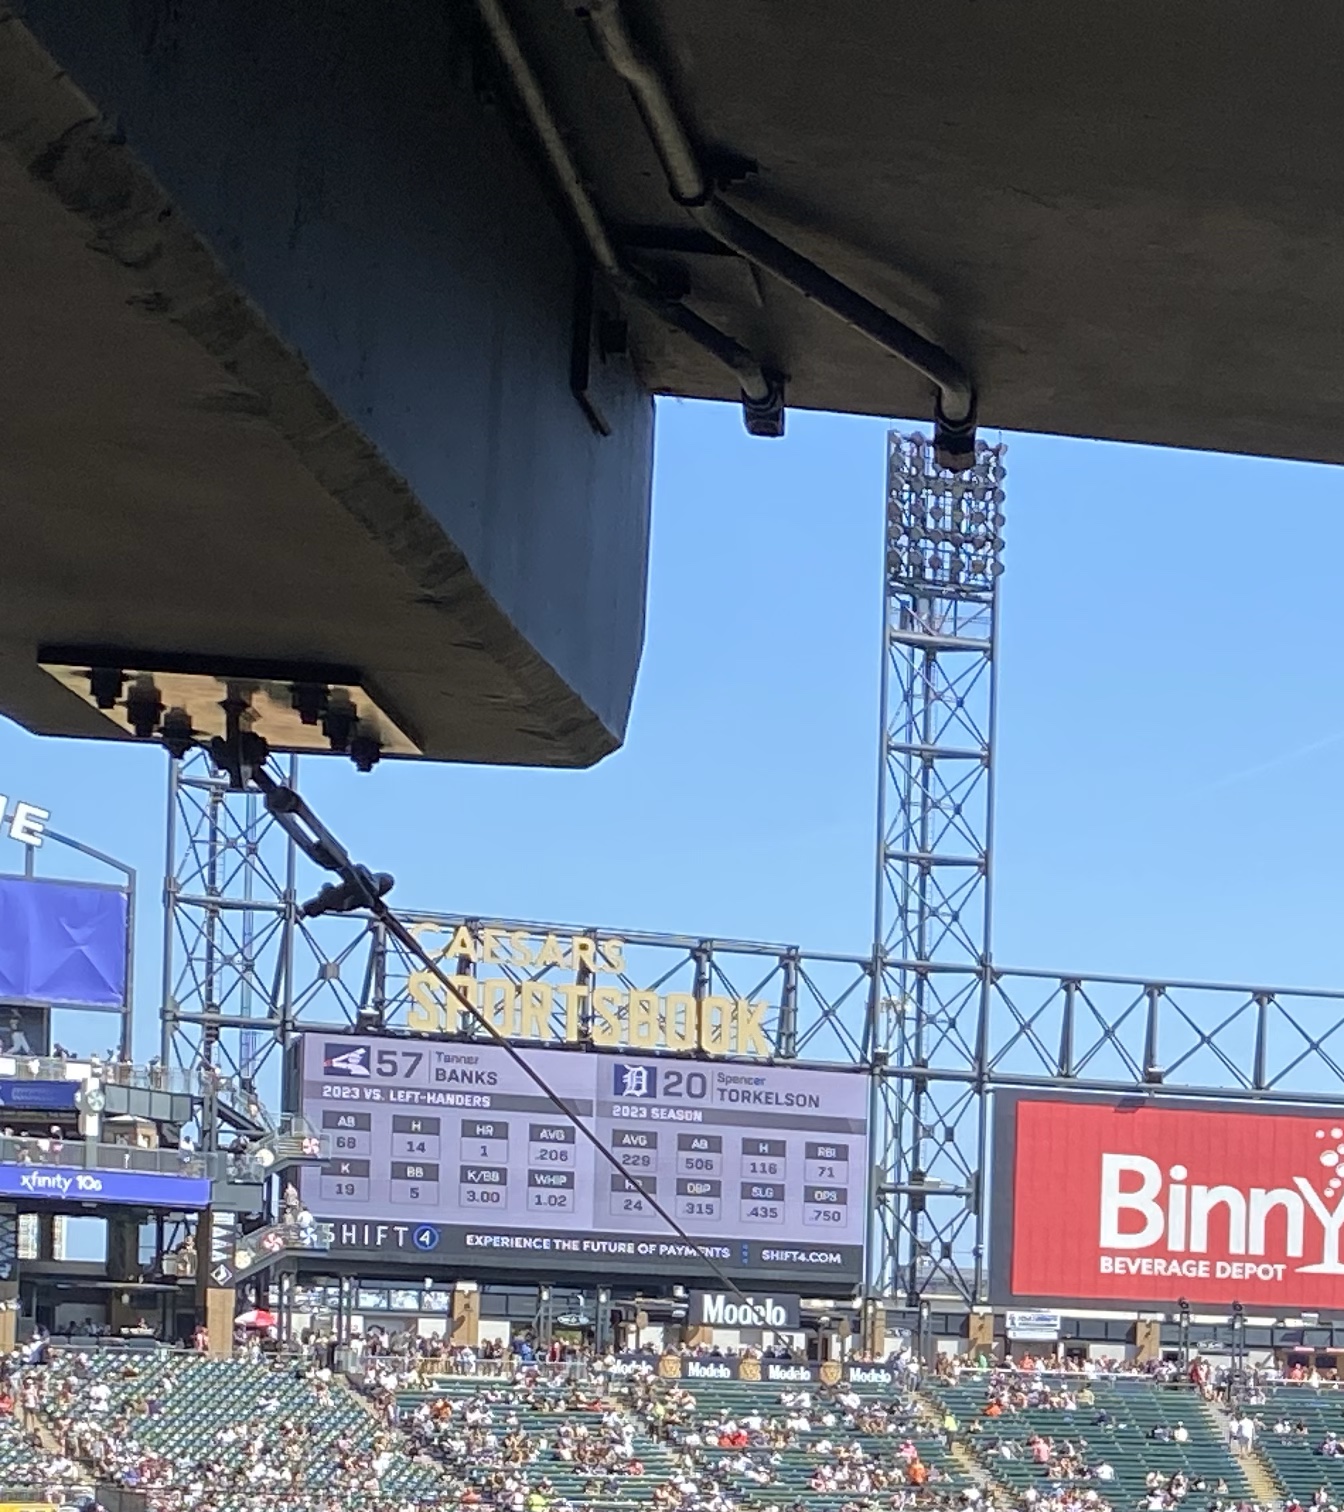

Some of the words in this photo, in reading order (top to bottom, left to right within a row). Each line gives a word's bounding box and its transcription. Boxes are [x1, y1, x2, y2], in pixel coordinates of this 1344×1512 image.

[409, 923, 625, 974] CAESARS
[408, 972, 771, 1057] SPORTSBOOK
[376, 1051, 423, 1078] 57
[436, 1051, 478, 1065] Tanner
[435, 1068, 498, 1085] BANKS
[663, 1071, 707, 1098] 20
[717, 1073, 766, 1086] Spencer
[323, 1085, 360, 1099] 2023
[364, 1088, 384, 1101] VS.
[390, 1090, 491, 1108] LEFT-HANDERS
[718, 1088, 820, 1108] TORKELSON
[613, 1106, 647, 1118] 2023
[651, 1108, 702, 1122] SEASON
[338, 1116, 355, 1127] AB
[476, 1125, 493, 1136] HR
[540, 1130, 564, 1140] AVG
[337, 1136, 356, 1148] 68
[407, 1141, 425, 1152] 14
[535, 1149, 568, 1162] .206
[622, 1135, 647, 1146] AVG
[692, 1139, 708, 1149] AB
[686, 1158, 713, 1170] 506
[750, 1162, 777, 1175] 116
[819, 1167, 834, 1178] 71
[20, 1171, 73, 1192] xfinity
[535, 1175, 566, 1185] WHIP
[336, 1183, 354, 1195] 19
[467, 1191, 499, 1203] 3.00
[535, 1195, 567, 1206] 1.02
[624, 1200, 642, 1211] 24
[747, 1207, 778, 1218] .435
[810, 1210, 840, 1222] .750
[325, 1223, 408, 1246] SHIFT
[466, 1234, 550, 1250] EXPERIENCE
[554, 1236, 580, 1251] THE
[583, 1240, 634, 1254] FUTURE
[638, 1242, 656, 1255] OF
[761, 1250, 841, 1264] SHIFT4.COM
[1100, 1256, 1210, 1279] BEVERAGE
[1215, 1259, 1285, 1281] DEPOT
[688, 1362, 730, 1379] Modelo
[769, 1364, 811, 1381] Modelo
[850, 1367, 891, 1384] Modelo
